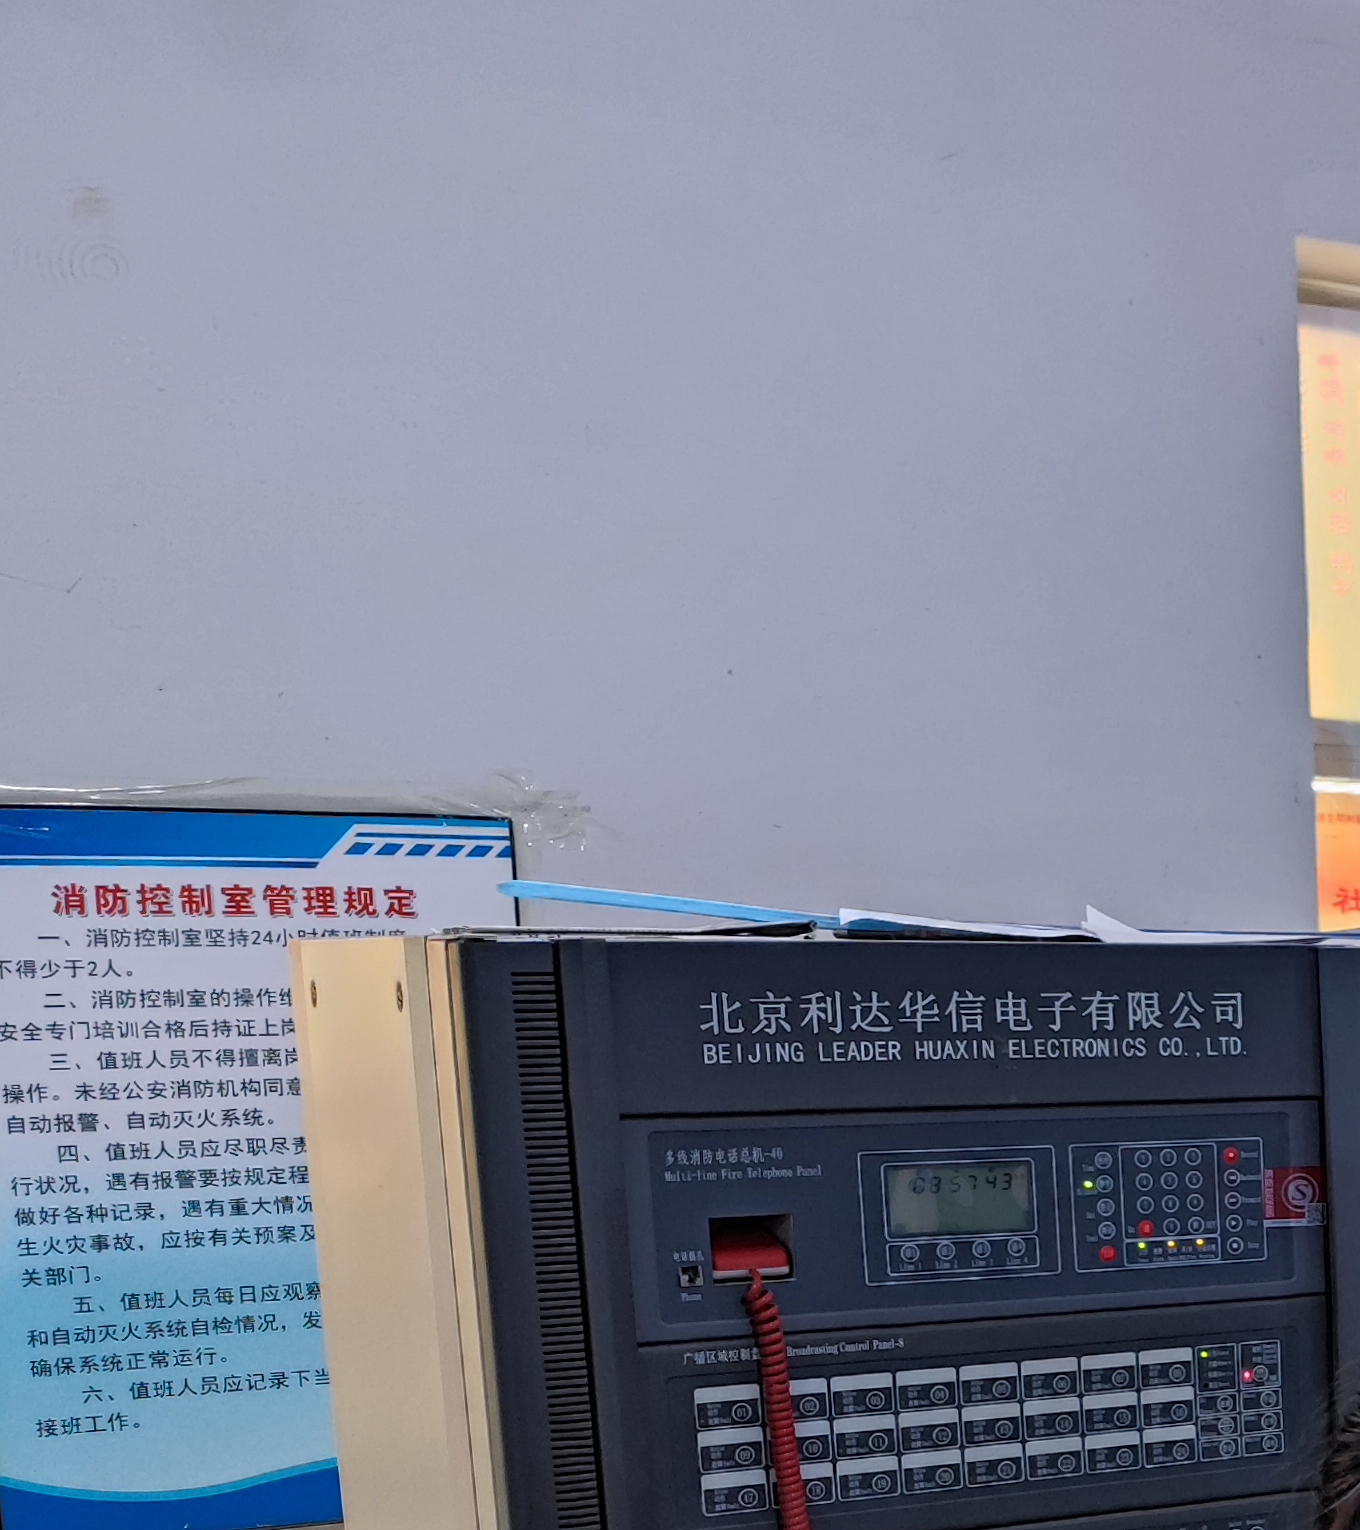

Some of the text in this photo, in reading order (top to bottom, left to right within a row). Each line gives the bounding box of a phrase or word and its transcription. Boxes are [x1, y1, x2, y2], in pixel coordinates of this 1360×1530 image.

[51, 883, 419, 918] 消防控制室管理规定
[0, 958, 135, 980] 不得少于2人。
[700, 990, 1246, 1036] 北京利达华信电子有限公司
[703, 1041, 805, 1065] BEIJING
[818, 1040, 901, 1063] LEADER
[915, 1039, 995, 1061] HUAXIN
[1009, 1037, 1147, 1059] ELECTRONICS
[7, 1109, 277, 1135] 自动报警、自动灭火系统。
[747, 1167, 793, 1180] Telephone
[21, 1266, 103, 1288] 关部门。
[786, 1342, 839, 1358] Broadcasting
[839, 1340, 870, 1352] Control
[29, 1347, 228, 1378] 确保系统正常运行。
[35, 1412, 141, 1438] 接班工作。
